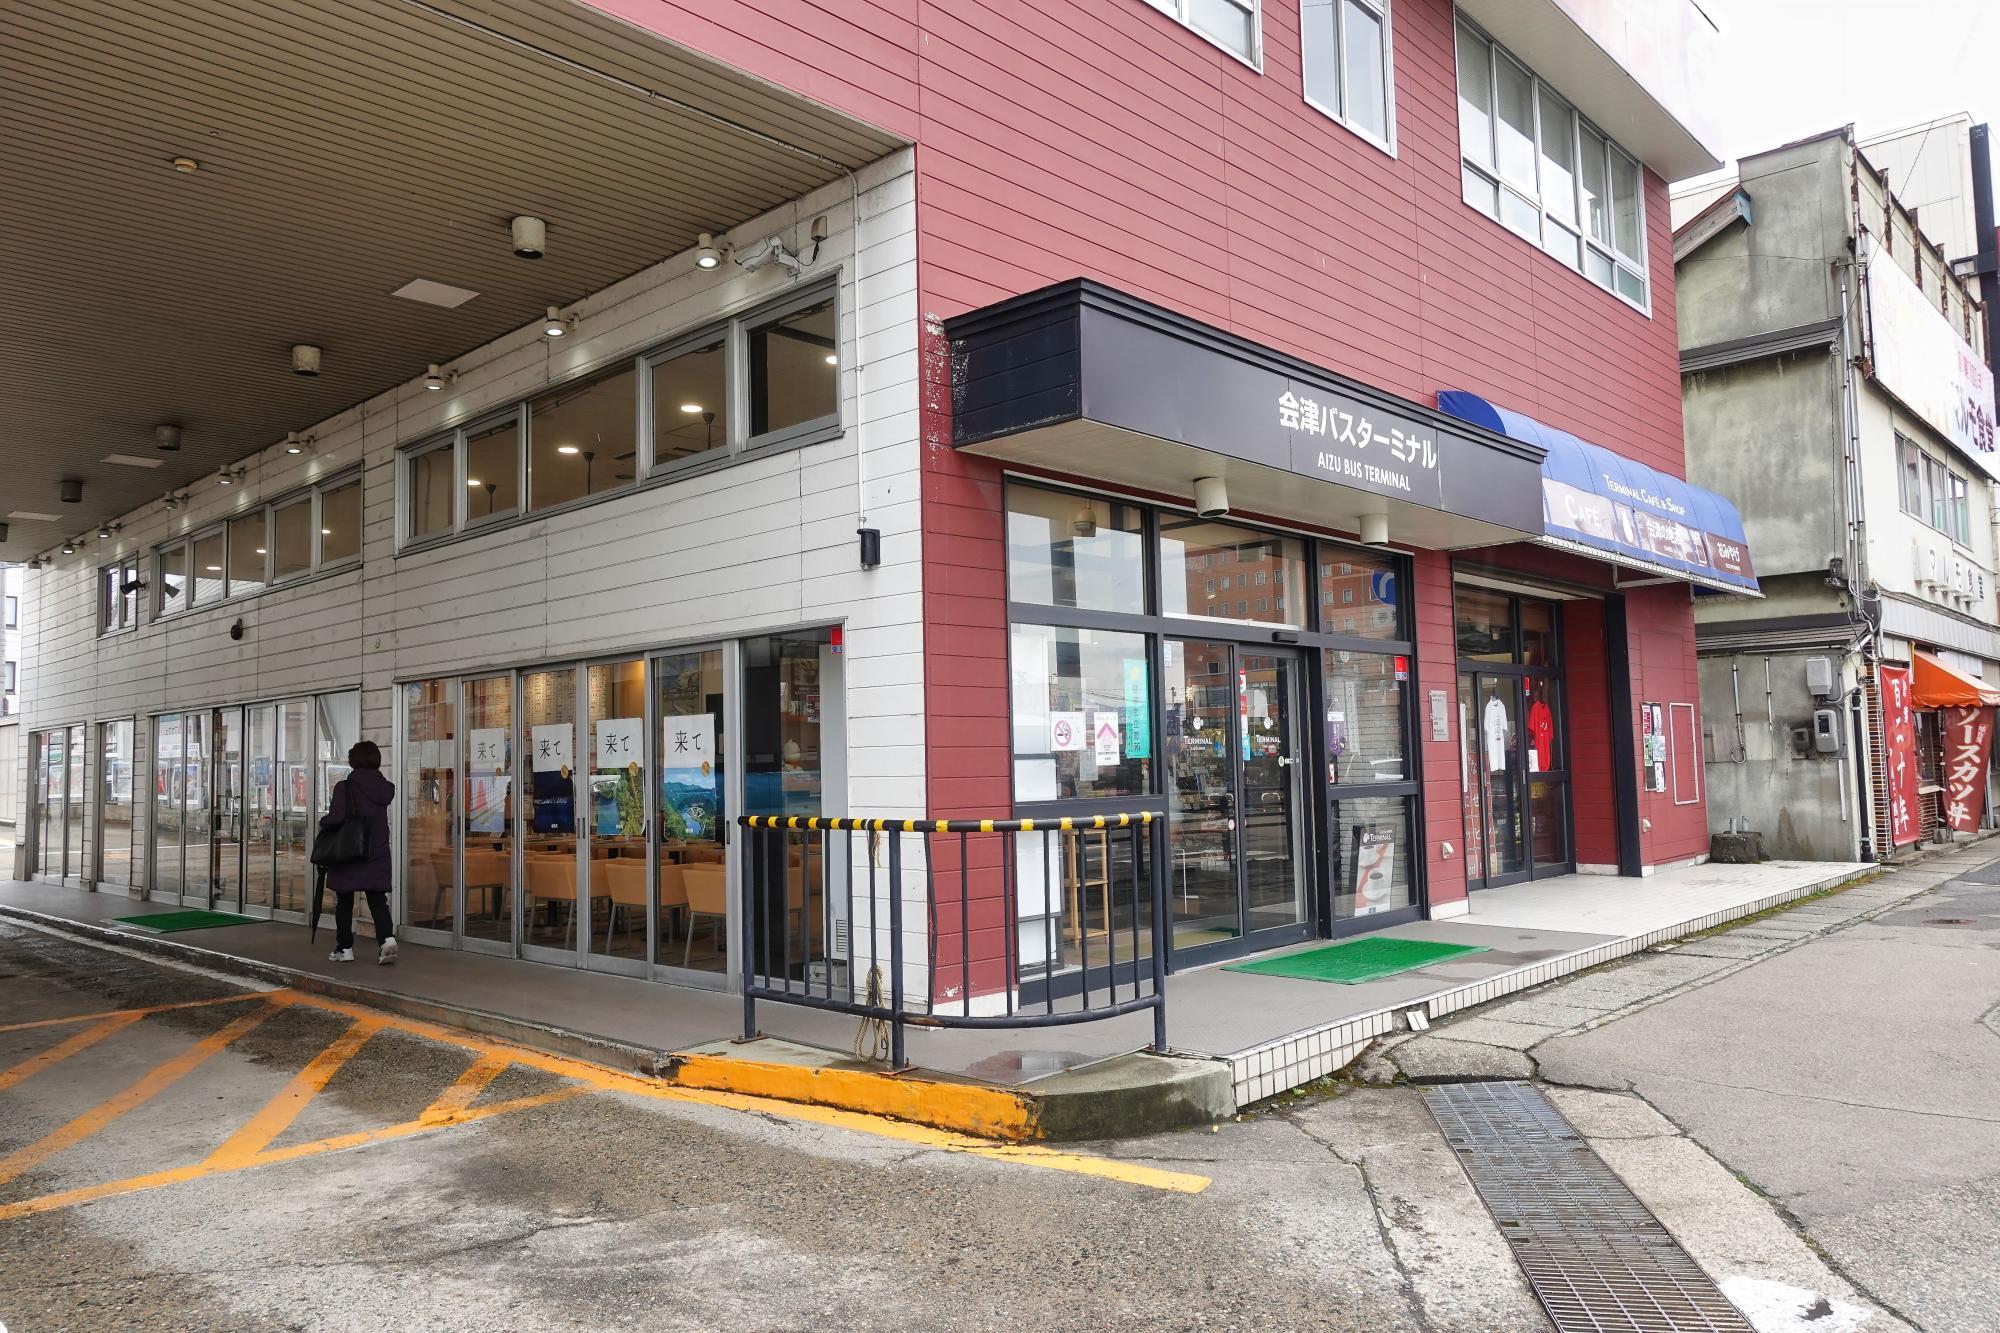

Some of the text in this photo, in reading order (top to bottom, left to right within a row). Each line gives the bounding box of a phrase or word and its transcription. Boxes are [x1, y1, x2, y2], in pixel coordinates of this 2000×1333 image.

[1278, 391, 1438, 470] 会津バスターミナル
[1317, 451, 1411, 492] AIZU BUS TERMINAL
[539, 738, 561, 760] 来て
[605, 733, 631, 756] 来て
[674, 729, 703, 754] 来て
[1947, 708, 1981, 827] ソースカツ丼
